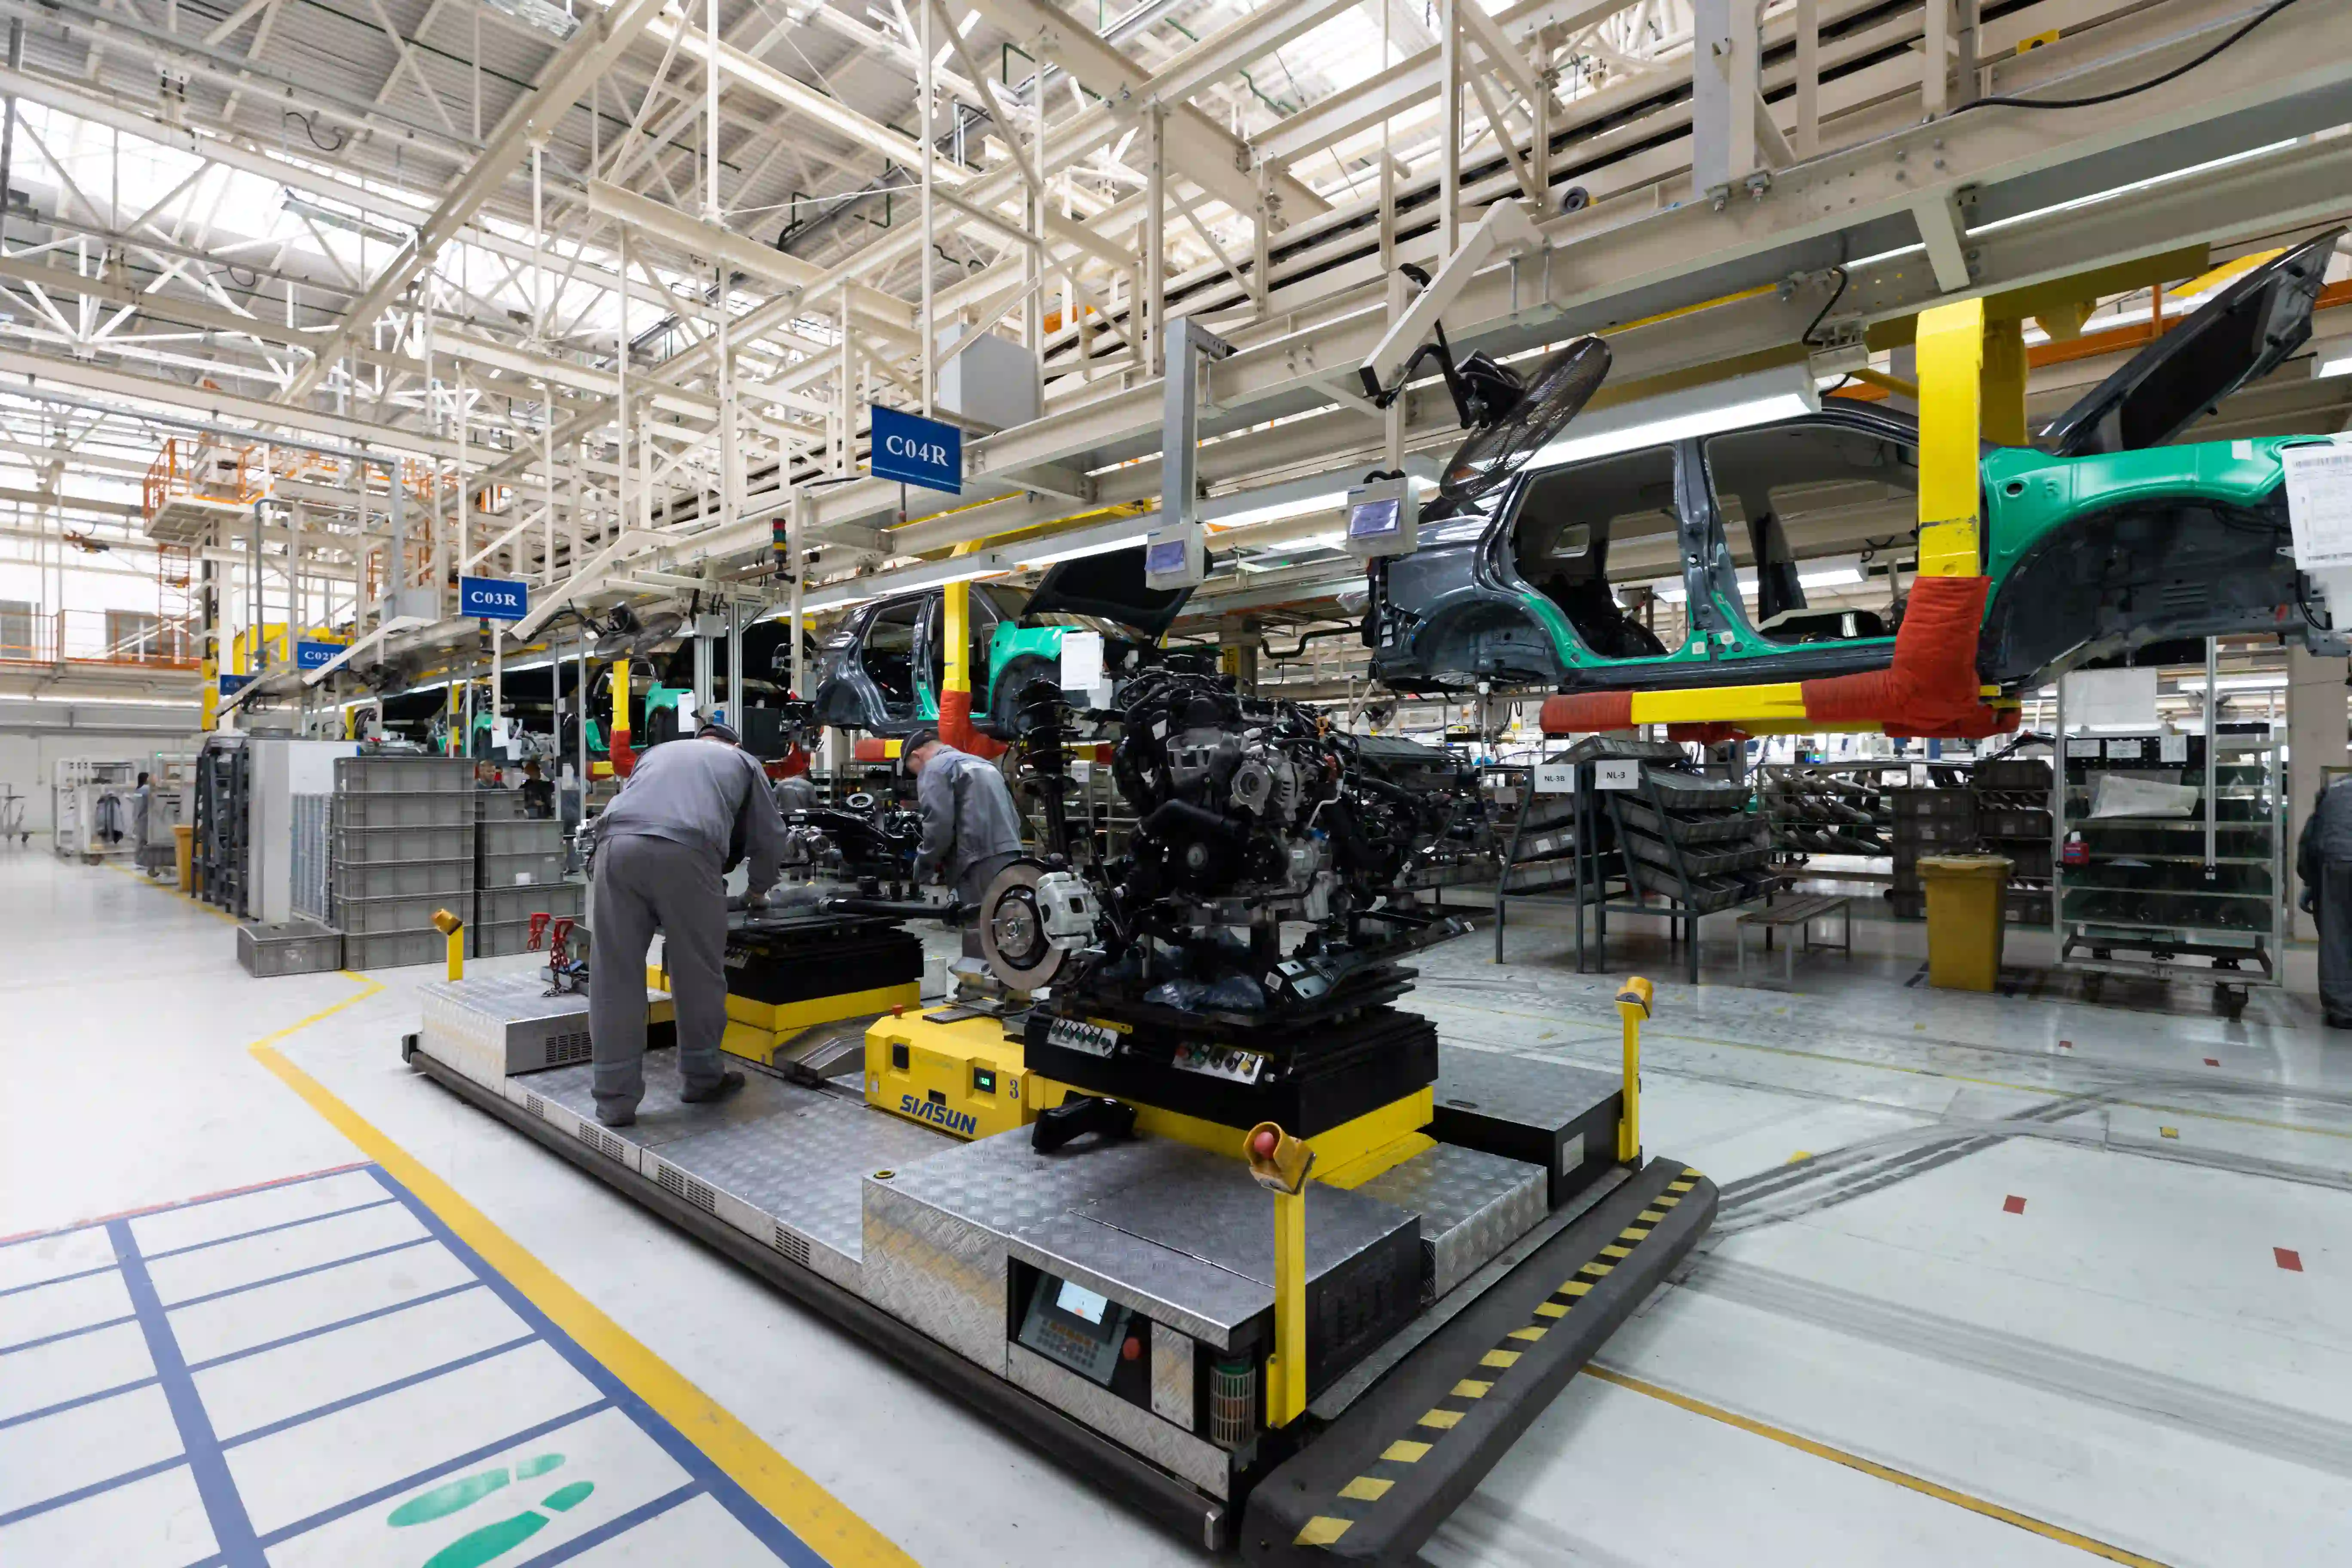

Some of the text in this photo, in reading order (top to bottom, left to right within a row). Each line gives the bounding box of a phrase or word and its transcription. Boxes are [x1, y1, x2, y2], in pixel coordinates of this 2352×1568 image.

[886, 435, 949, 467] C04R
[471, 591, 518, 606] C03R
[1010, 1079, 1019, 1099] 3
[900, 1094, 977, 1134] SIASUN
